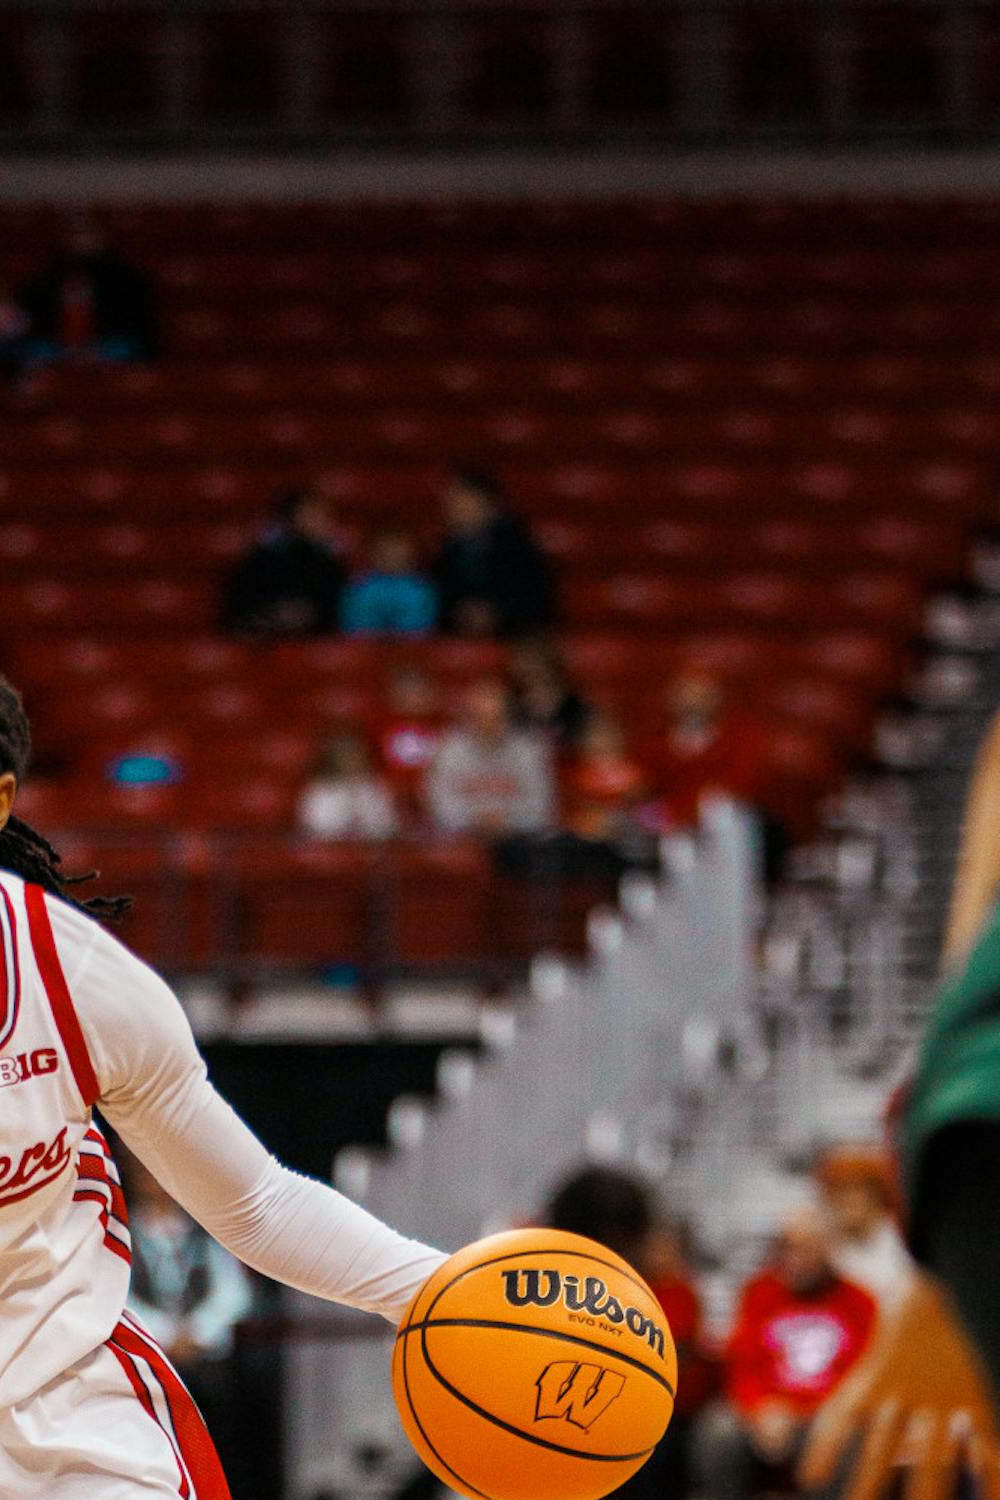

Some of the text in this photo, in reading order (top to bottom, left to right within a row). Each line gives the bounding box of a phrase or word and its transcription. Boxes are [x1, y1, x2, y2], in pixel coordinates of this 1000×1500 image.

[501, 1269, 665, 1361] Wilson
[567, 1313, 625, 1337] EVO NXT
[534, 1360, 628, 1431] W
